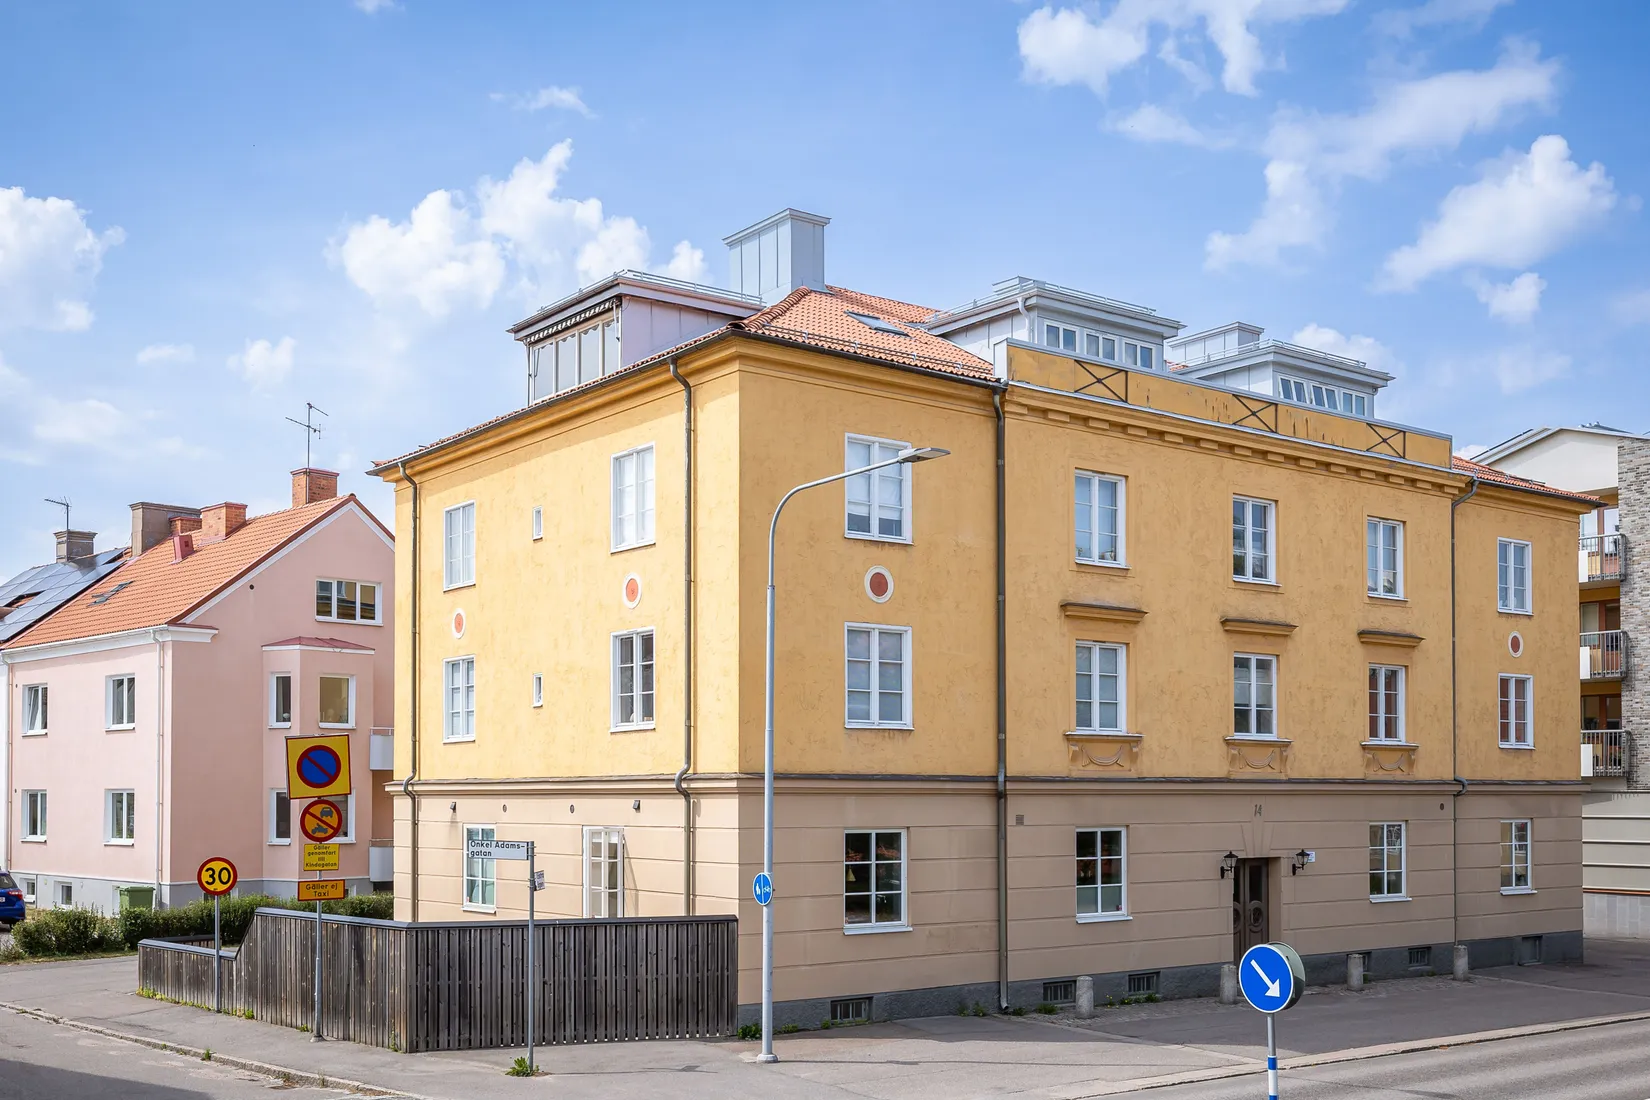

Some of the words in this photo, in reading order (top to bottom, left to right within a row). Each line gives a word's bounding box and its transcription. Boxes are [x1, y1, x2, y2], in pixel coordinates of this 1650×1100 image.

[1254, 804, 1262, 816] 14
[470, 840, 492, 848] Onkel
[205, 867, 231, 885] 30
